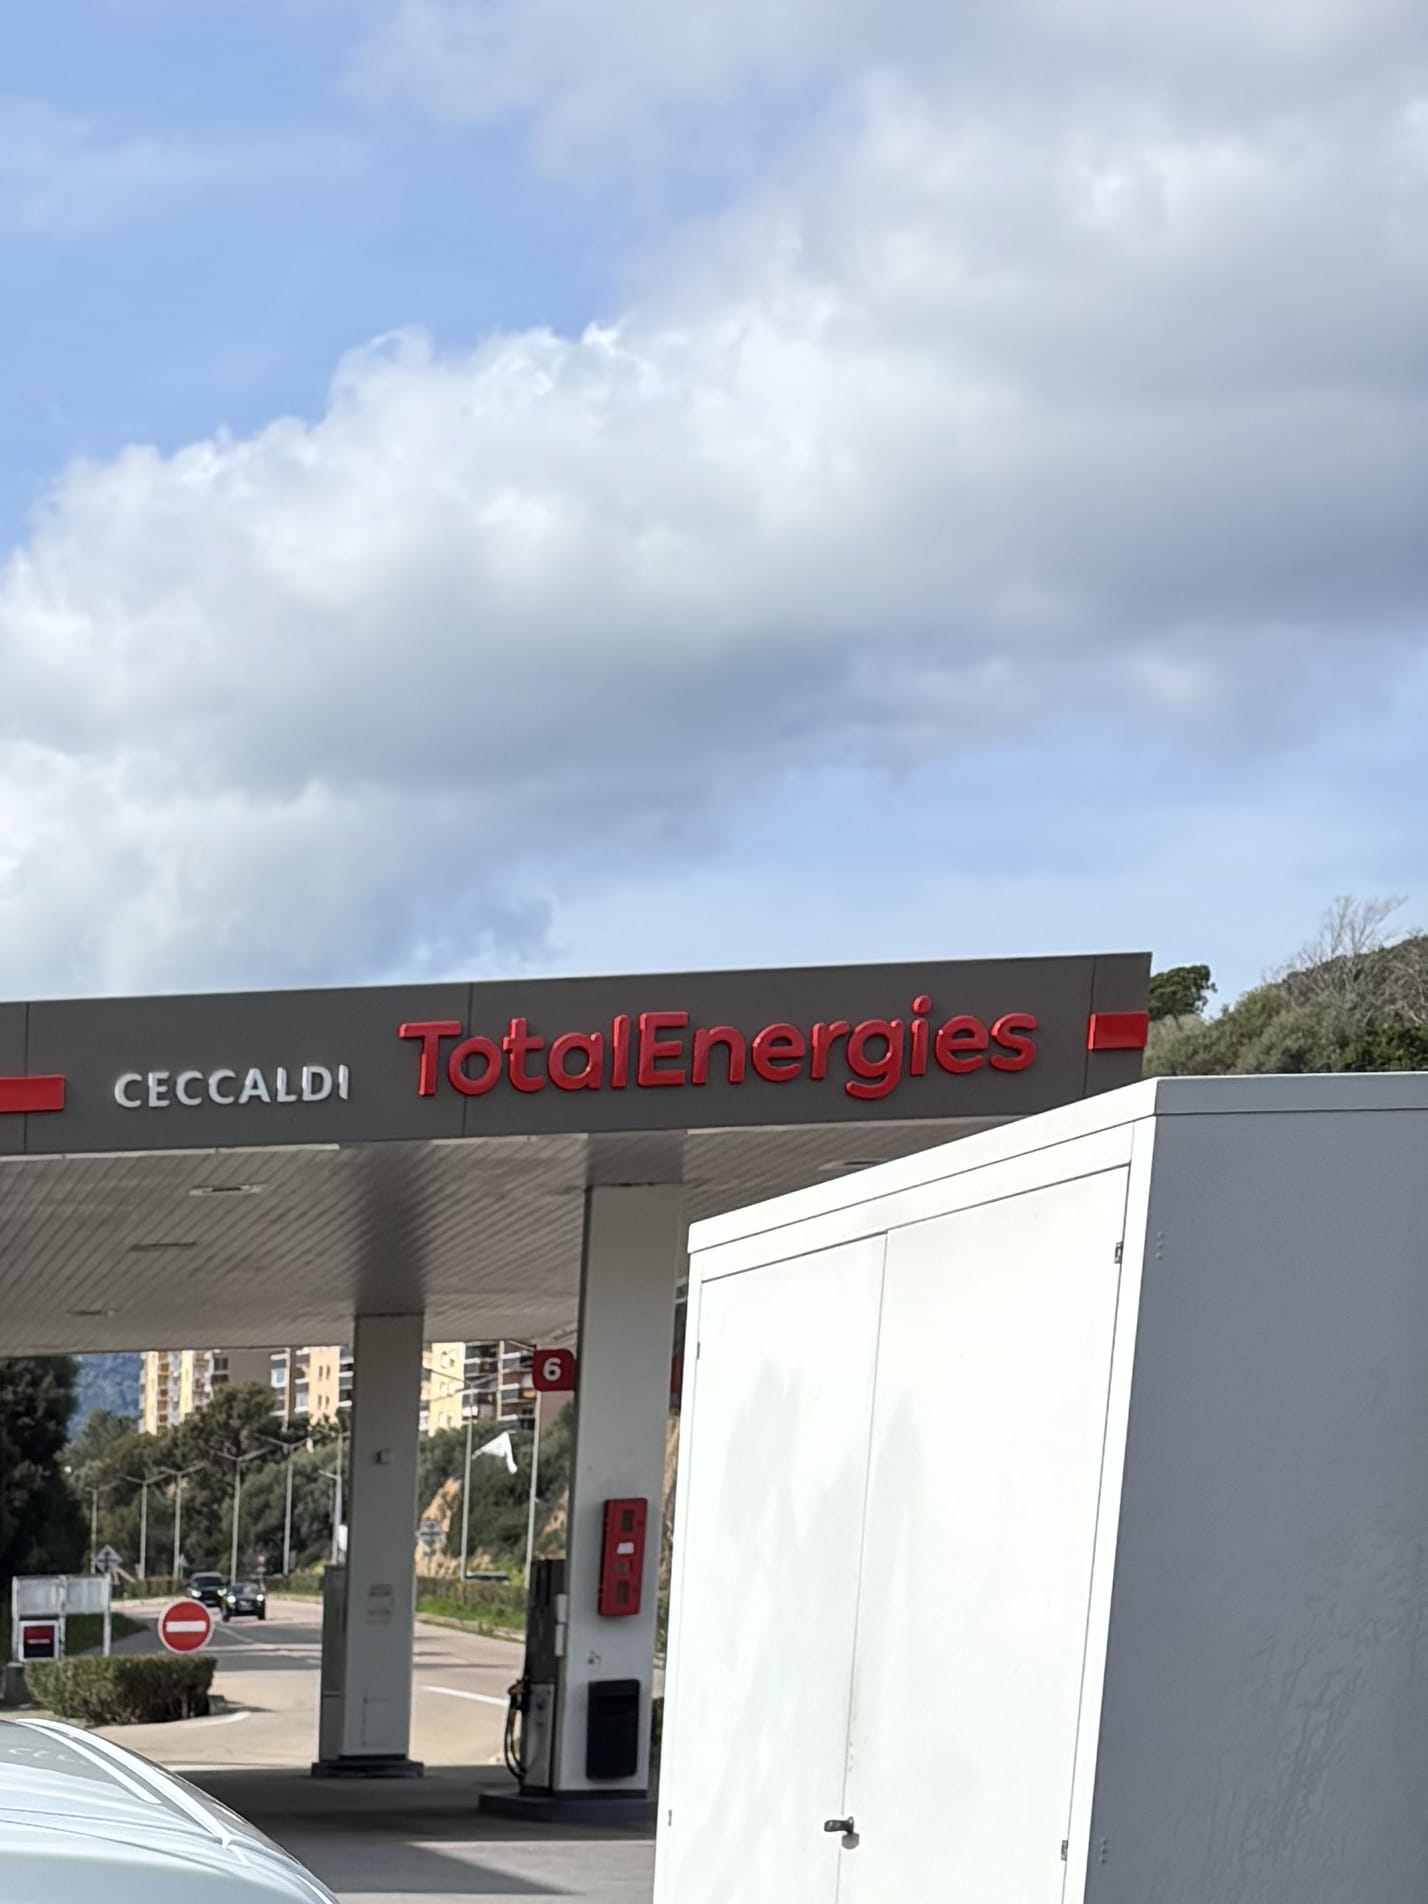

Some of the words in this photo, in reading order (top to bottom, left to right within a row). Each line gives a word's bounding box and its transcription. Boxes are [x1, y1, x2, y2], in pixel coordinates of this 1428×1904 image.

[398, 994, 1040, 1101] TotalEnergies
[113, 1062, 351, 1108] CECCALDI
[543, 1357, 562, 1382] 6
